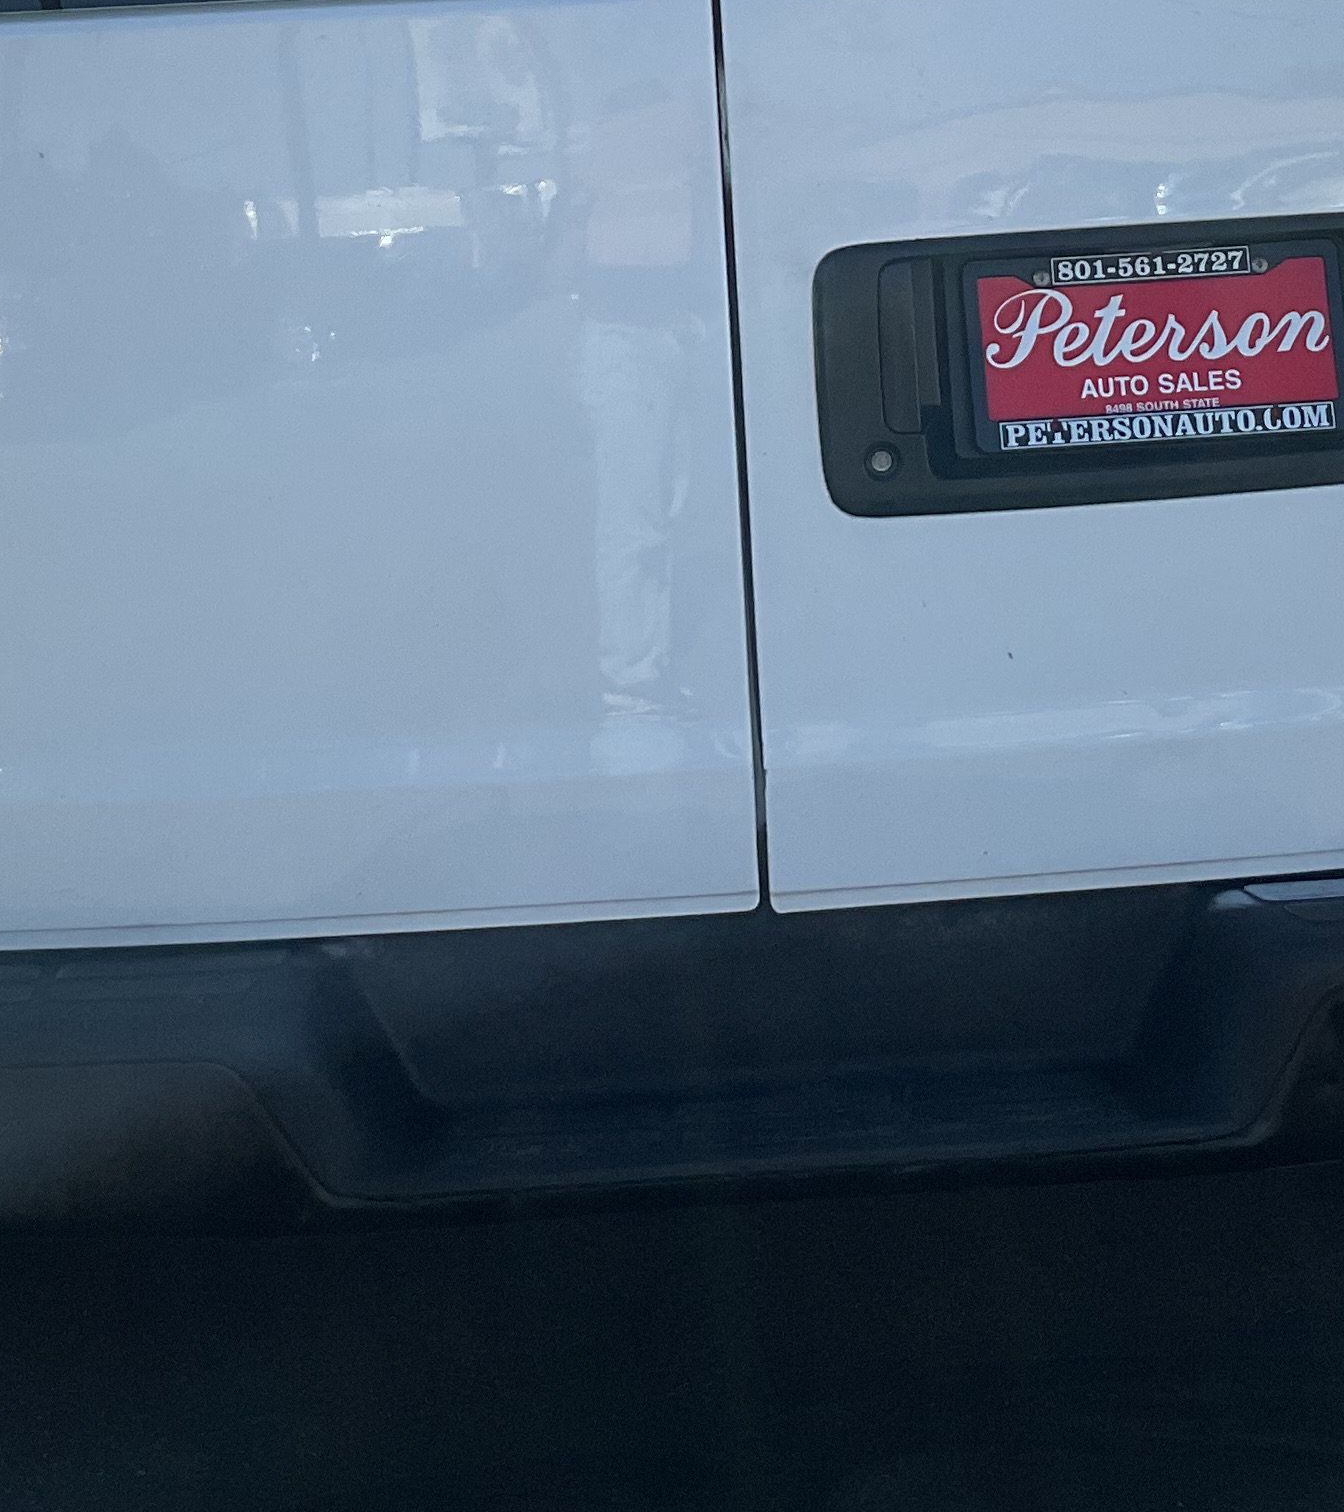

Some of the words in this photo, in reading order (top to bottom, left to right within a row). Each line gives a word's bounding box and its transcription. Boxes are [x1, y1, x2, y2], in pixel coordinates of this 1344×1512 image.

[1058, 250, 1244, 281] 801-561-2727
[985, 288, 1329, 369] Peterson
[1080, 374, 1149, 399] AUTO
[1158, 369, 1242, 394] SALES
[1136, 400, 1179, 412] SOUTH
[1182, 397, 1221, 409] STATE
